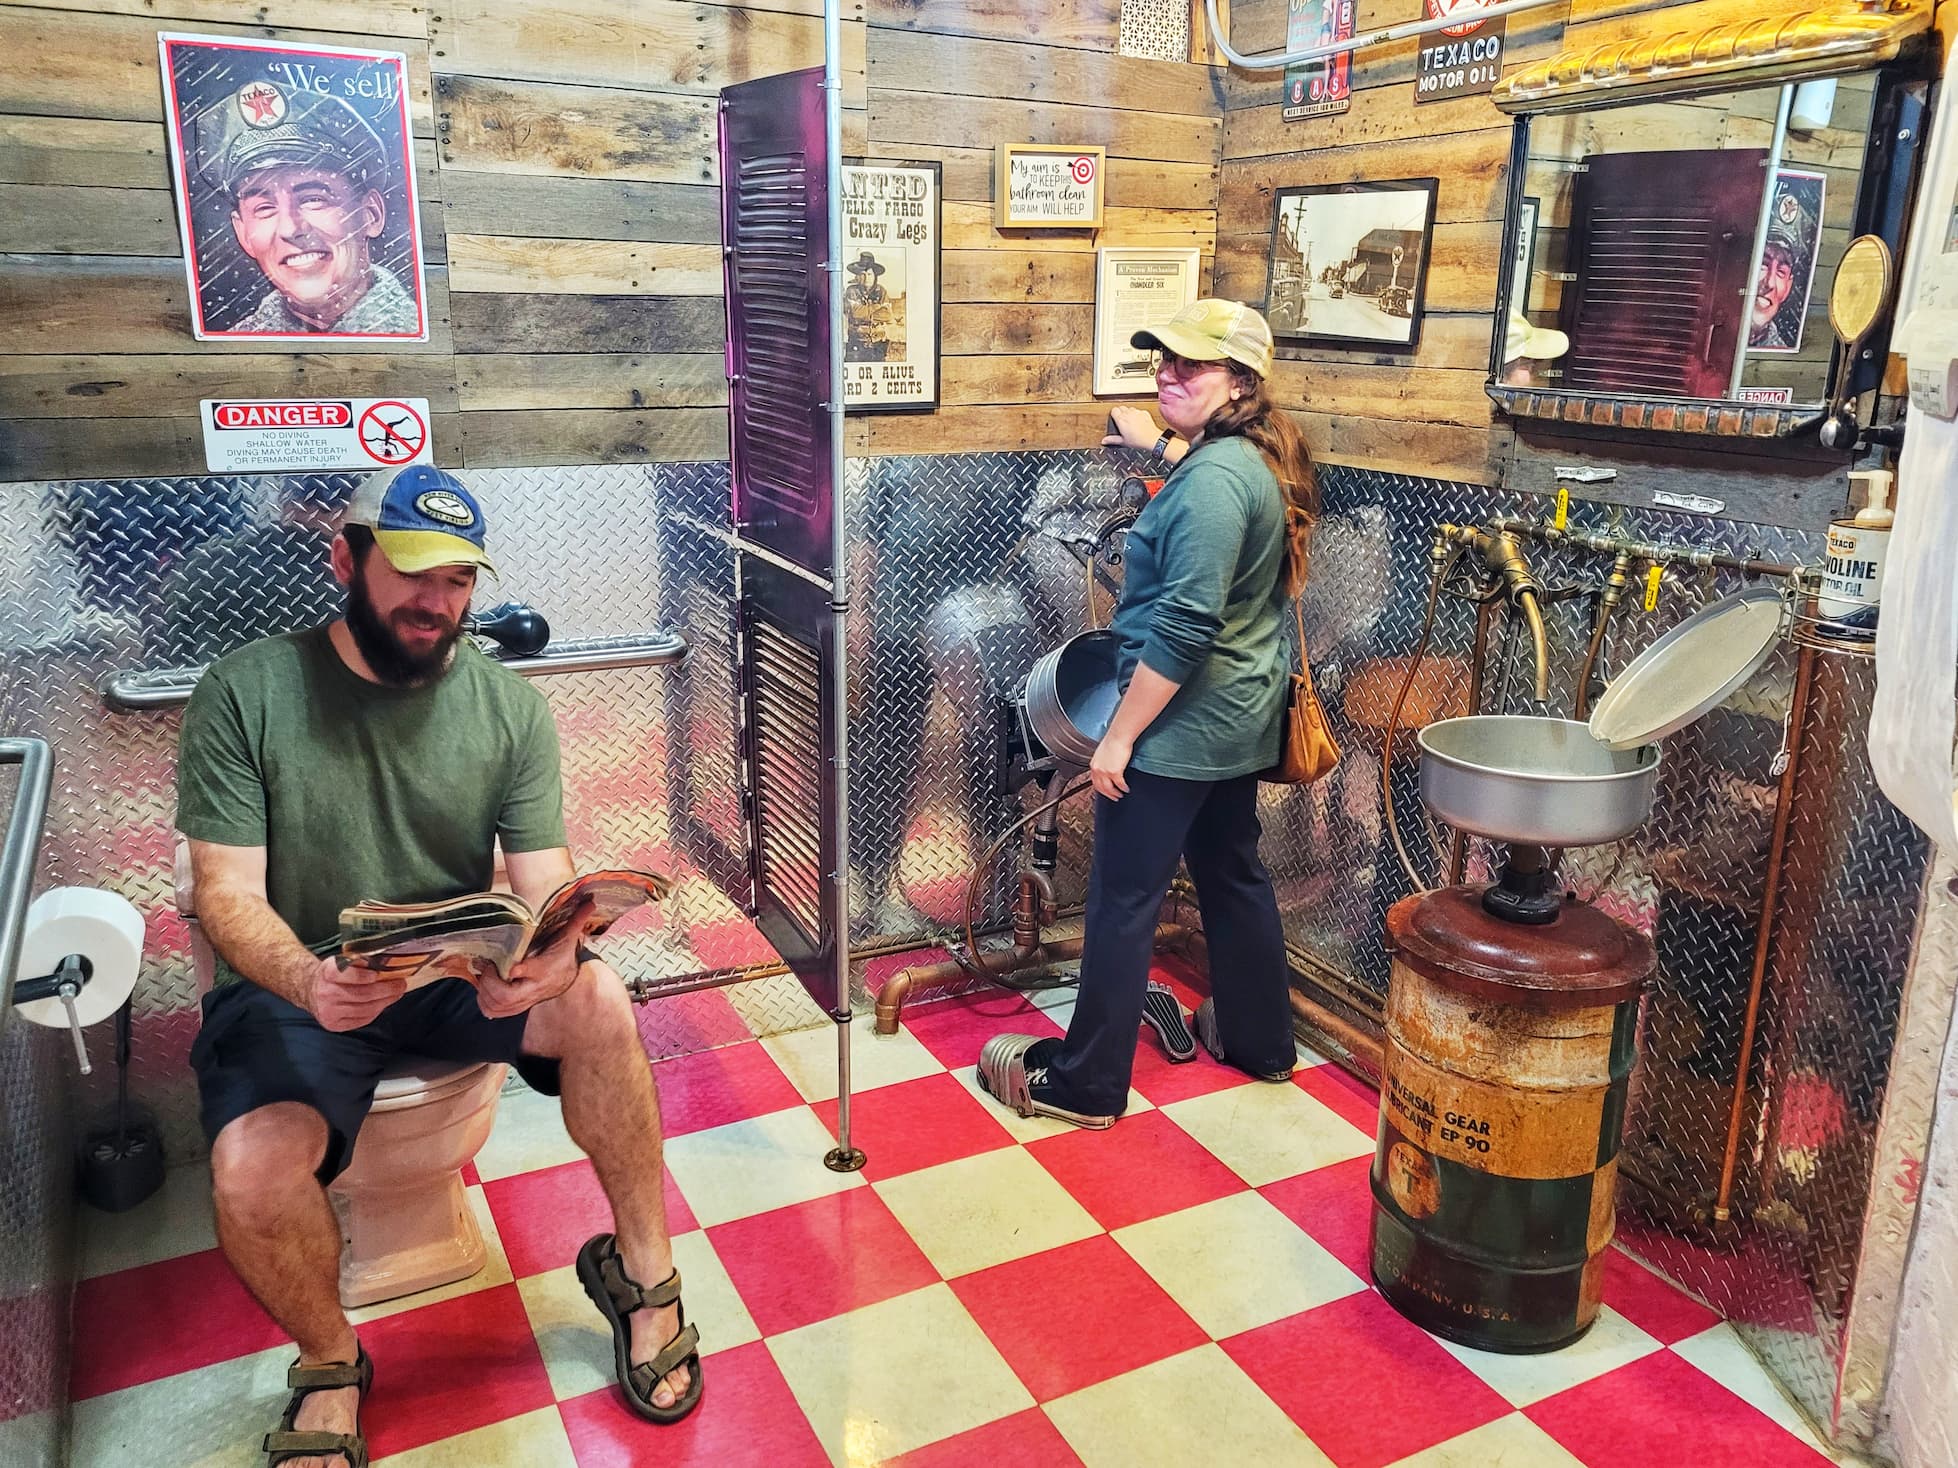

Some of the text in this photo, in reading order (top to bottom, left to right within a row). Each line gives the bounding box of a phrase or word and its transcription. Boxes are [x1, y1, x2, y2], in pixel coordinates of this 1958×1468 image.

[1422, 35, 1500, 71] TEXACO
[344, 71, 393, 99] sell
[1419, 65, 1497, 93] MOTOR OIL
[242, 88, 276, 102] TEXACO
[1011, 159, 1060, 178] My aim is
[841, 171, 927, 201] NTED
[1030, 174, 1072, 187] TO KEEP THIS
[1010, 183, 1086, 201] bathroom clean
[885, 201, 924, 217] FARGO
[1010, 202, 1085, 215] YOUR AIM WILL HELP
[849, 217, 927, 245] Crazy Legs
[1130, 281, 1165, 289] CHANDLER SIX
[859, 367, 872, 380] OR
[882, 366, 914, 379] ALIVE
[872, 382, 877, 395] 2
[227, 406, 339, 426] DANGER
[246, 439, 327, 448] SHALLOW WATER
[262, 431, 310, 440] NO DIVING
[227, 447, 347, 457] DIVING MAY CAUSE DEATH
[235, 455, 341, 464] OR PERMANENT INJURY
[1831, 538, 1854, 549] TEXACO
[1824, 555, 1878, 580] VOLINE
[1824, 576, 1864, 597] TOR OIL
[1444, 1111, 1491, 1136] GEAR
[1440, 1127, 1460, 1142] EP
[1465, 1136, 1490, 1153] 90
